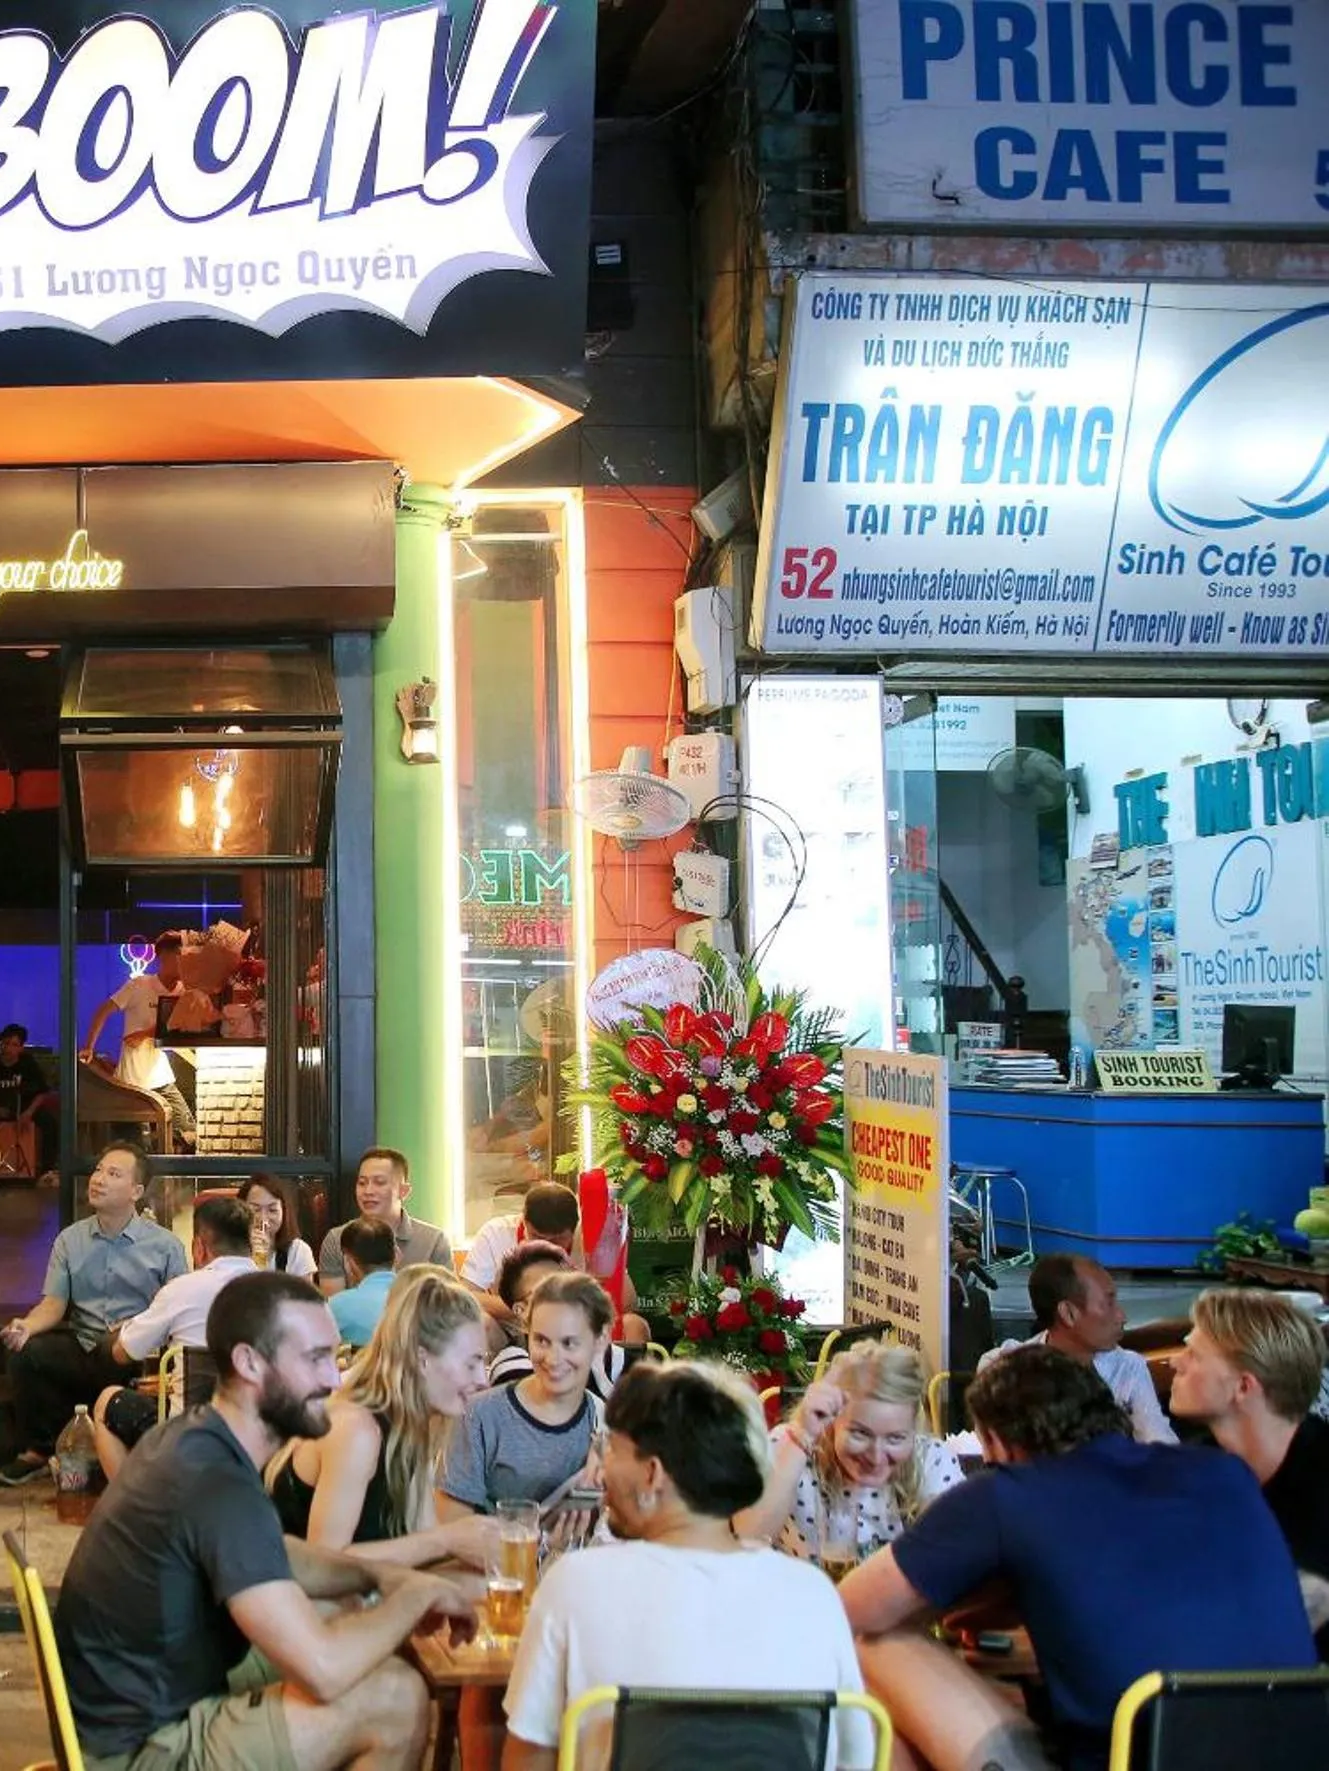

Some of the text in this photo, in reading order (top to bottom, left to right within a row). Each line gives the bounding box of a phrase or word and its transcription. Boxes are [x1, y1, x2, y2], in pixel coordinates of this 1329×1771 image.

[898, 0, 1297, 107] PRINCE
[974, 126, 1231, 203] CAFE
[183, 255, 281, 295] Ngọc
[811, 287, 862, 321] CÔNG
[868, 293, 889, 321] TY
[895, 294, 941, 322] TNHH
[892, 340, 916, 367] DU
[845, 499, 1050, 543] TẠI TP HÀ NỘI
[48, 529, 125, 588] choice
[780, 546, 838, 600] 52
[1117, 543, 1186, 575] Sinh
[1197, 542, 1278, 578] Café
[1206, 582, 1297, 598] Since 1993
[776, 613, 825, 641] Lương
[829, 614, 873, 642] Ngọc
[938, 612, 981, 638] Hoàn
[1035, 614, 1059, 638] Hà
[1063, 613, 1090, 642] Nội
[1190, 610, 1225, 645] well
[1240, 611, 1285, 645] Know
[1288, 615, 1308, 645] as
[1180, 942, 1324, 986] TheSinhTourist
[1101, 1055, 1204, 1074] SINH TOURIST
[1111, 1075, 1204, 1087] BOOKING
[852, 1120, 932, 1171] CHEAPEST ONE
[857, 1159, 925, 1193] GOOD QUALITY
